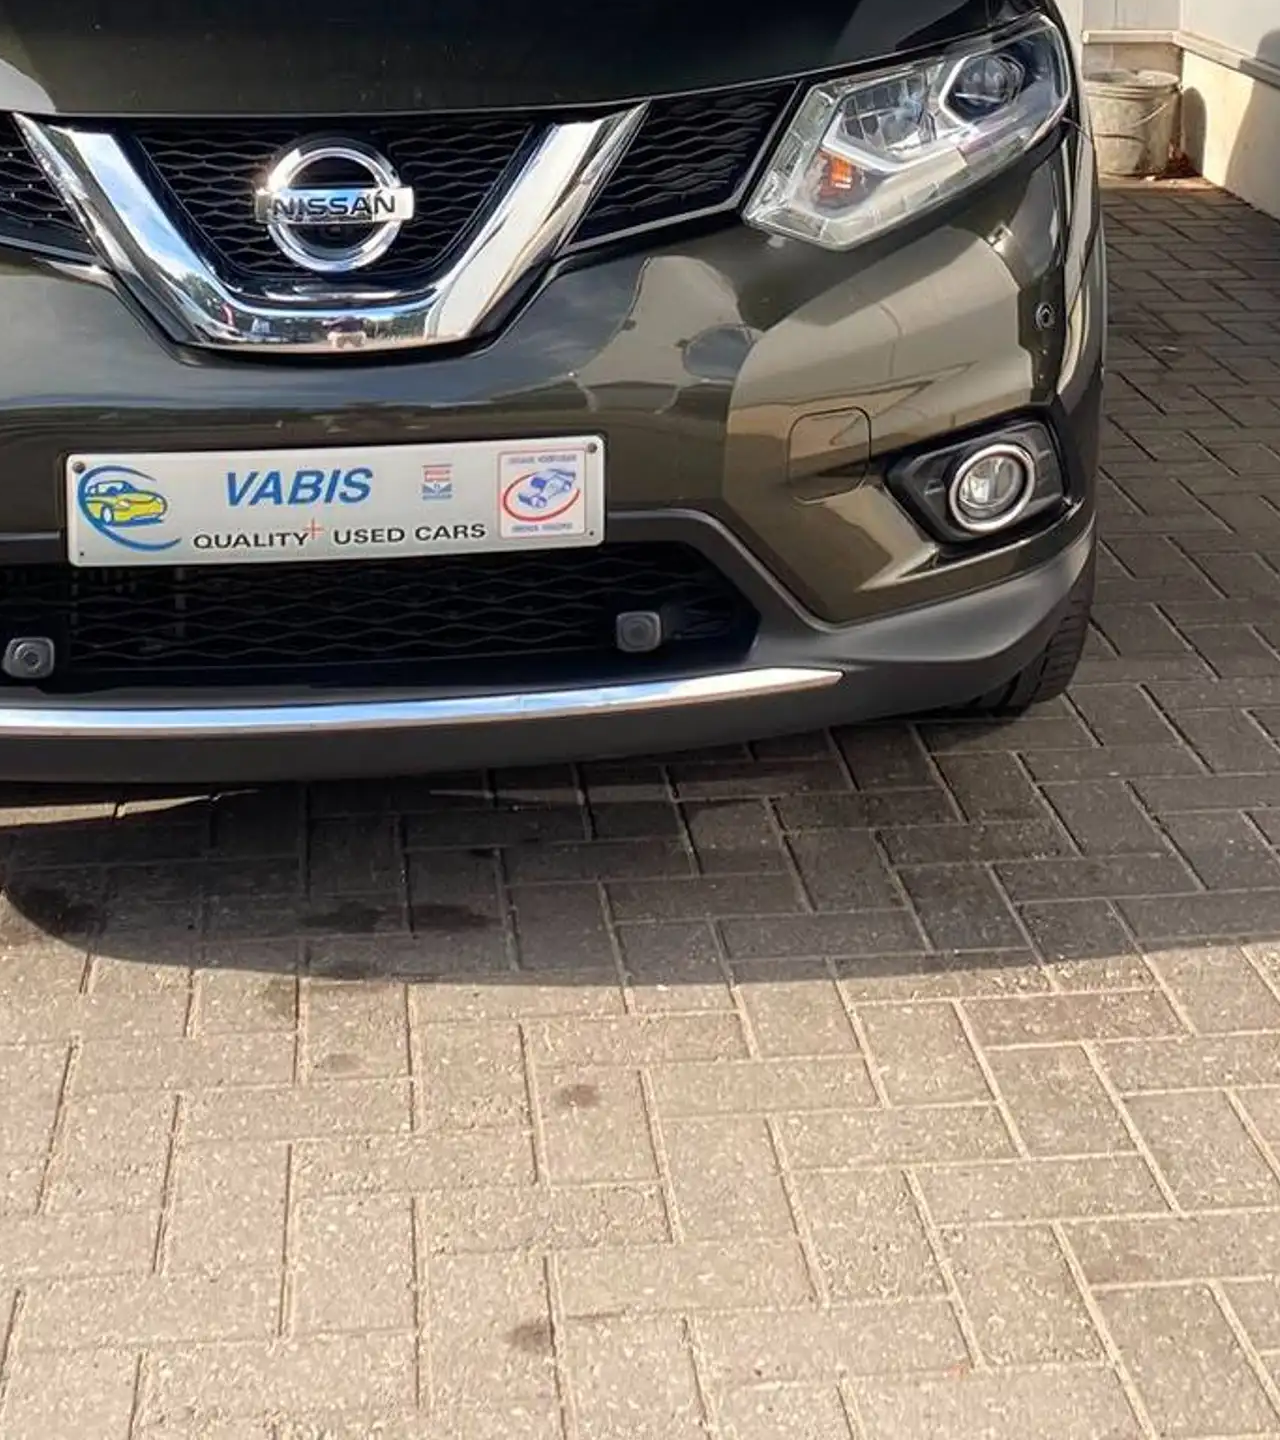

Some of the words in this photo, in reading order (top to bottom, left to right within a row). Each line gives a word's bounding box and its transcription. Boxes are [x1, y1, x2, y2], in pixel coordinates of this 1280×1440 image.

[273, 194, 396, 216] NISSAN
[224, 466, 374, 508] VABIS
[333, 525, 406, 546] USED
[414, 523, 487, 542] CARS
